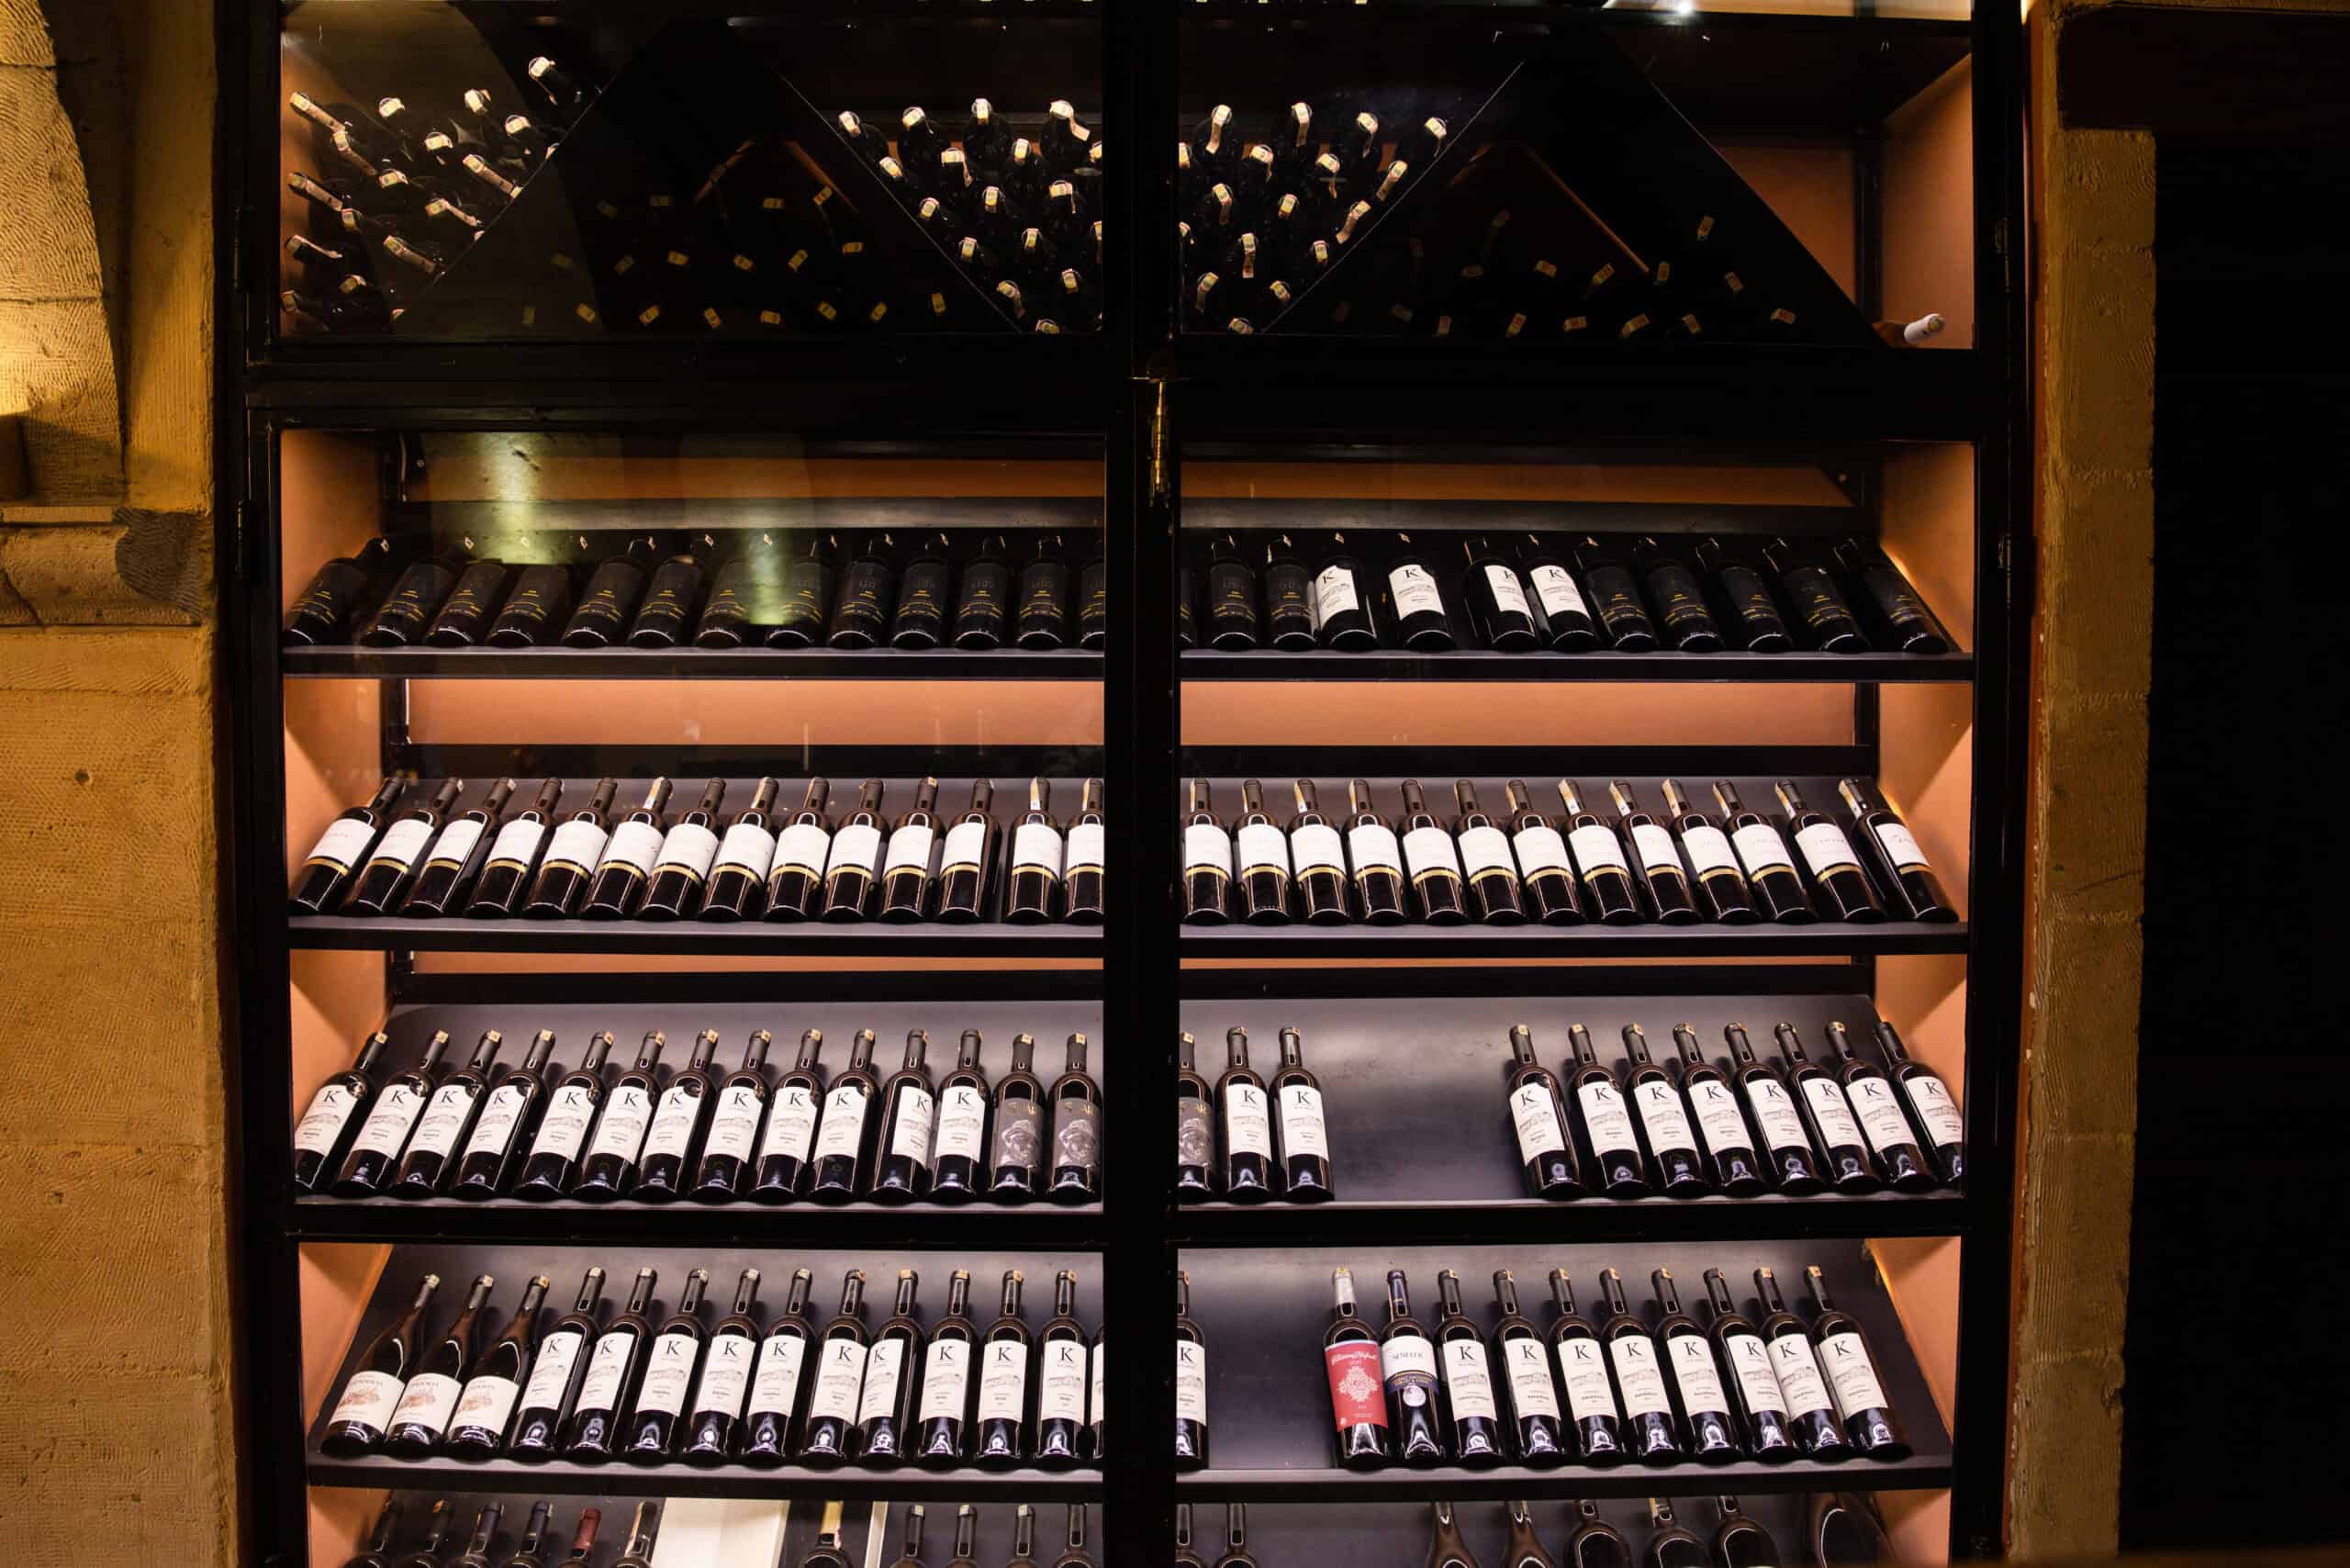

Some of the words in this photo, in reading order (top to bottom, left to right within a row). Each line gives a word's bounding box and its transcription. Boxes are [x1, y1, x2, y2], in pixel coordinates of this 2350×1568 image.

[1404, 568, 1418, 579] K
[1549, 568, 1563, 579] K
[1594, 1087, 1611, 1102] K
[1650, 1086, 1668, 1101] K
[1706, 1085, 1722, 1100] K
[1765, 1084, 1783, 1099] K
[1820, 1083, 1839, 1098] K
[1863, 1082, 1882, 1097] K
[1924, 1081, 1943, 1095] K
[322, 1090, 341, 1103] K
[390, 1090, 408, 1104] K
[440, 1090, 458, 1103] K
[493, 1091, 508, 1105] K
[565, 1091, 581, 1106] K
[623, 1092, 639, 1107] K
[669, 1092, 683, 1105] K
[733, 1092, 749, 1107] K
[789, 1092, 805, 1107] K
[835, 1092, 849, 1106] K
[957, 1092, 971, 1105] K
[1244, 1089, 1257, 1104] K
[1296, 1091, 1310, 1104] K
[1520, 1090, 1536, 1107] K
[546, 1338, 562, 1354] K
[599, 1339, 614, 1355] K
[666, 1339, 681, 1356] K
[722, 1340, 739, 1358] K
[773, 1341, 788, 1357] K
[838, 1345, 853, 1362] K
[939, 1345, 954, 1361] K
[1459, 1345, 1475, 1361] K
[1521, 1344, 1538, 1360] K
[1574, 1344, 1591, 1360] K
[1626, 1342, 1642, 1358] K
[1684, 1341, 1701, 1356] K
[1745, 1341, 1762, 1357] K
[1779, 1341, 1797, 1359] K
[1833, 1339, 1852, 1357] K
[998, 1347, 1012, 1361] K
[1060, 1346, 1073, 1362] K
[1180, 1346, 1193, 1362] K
